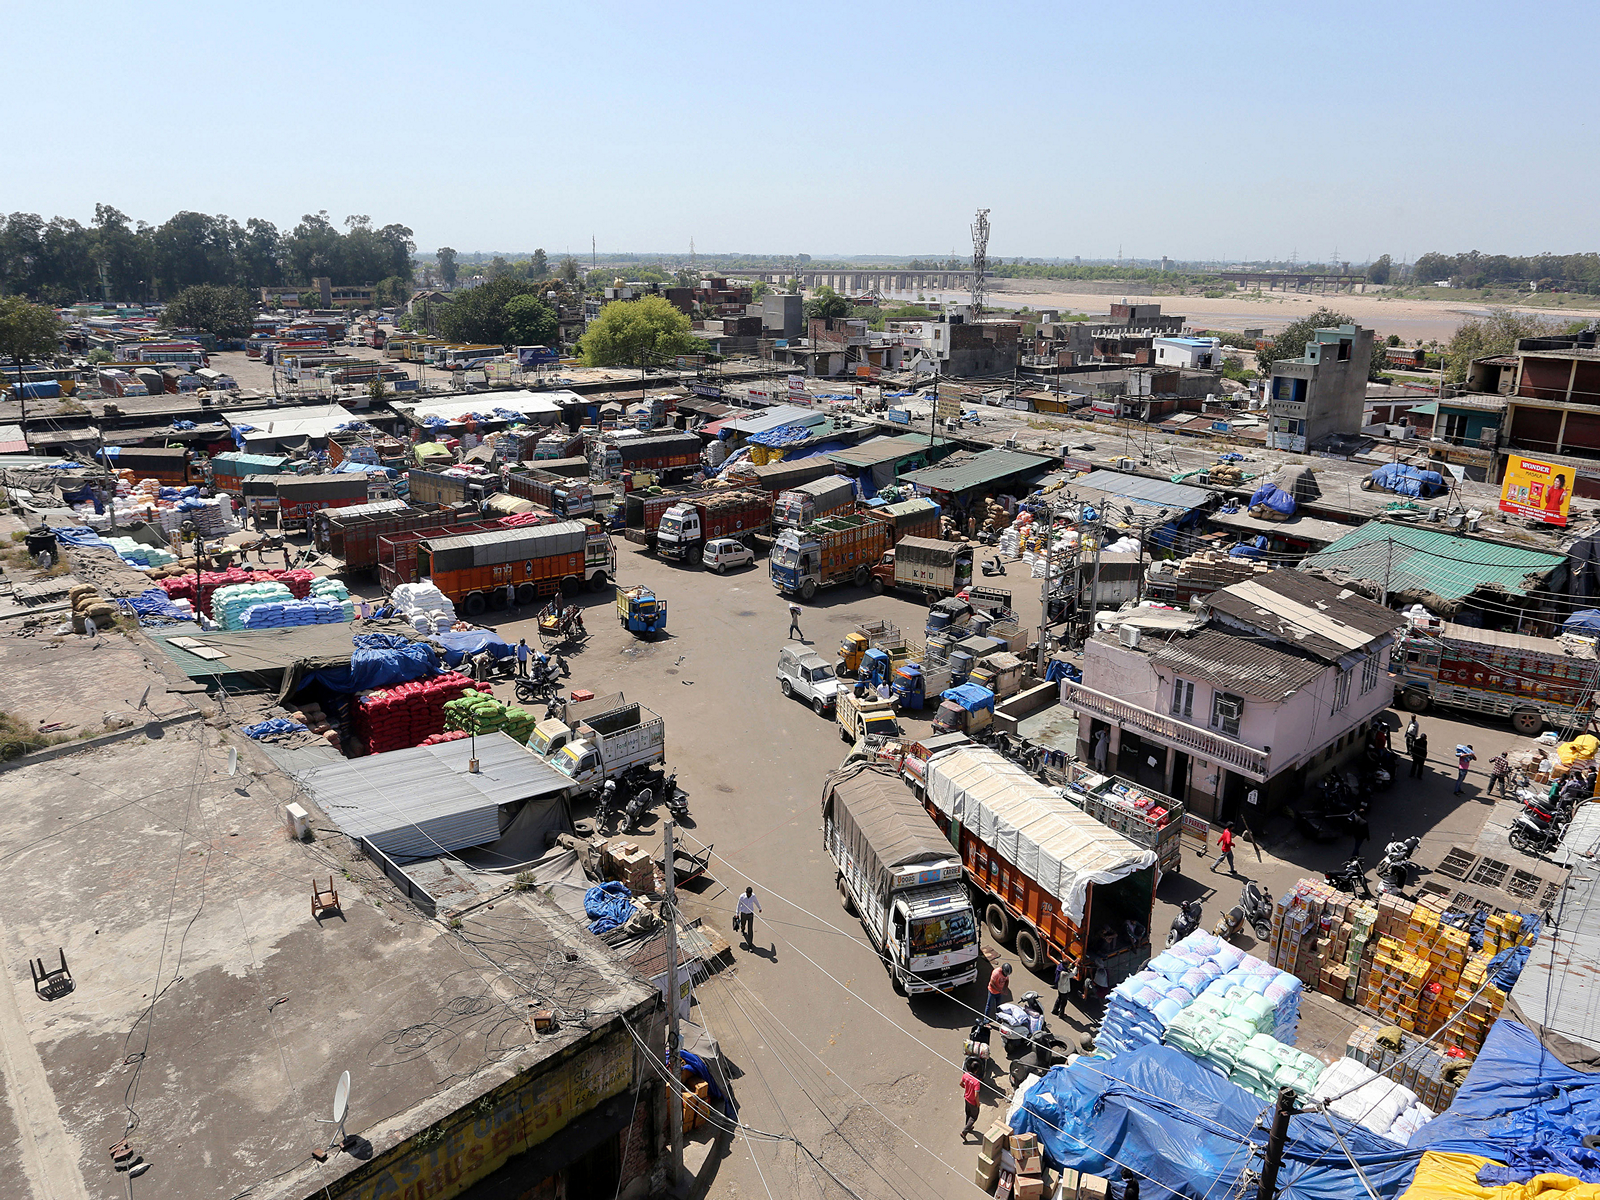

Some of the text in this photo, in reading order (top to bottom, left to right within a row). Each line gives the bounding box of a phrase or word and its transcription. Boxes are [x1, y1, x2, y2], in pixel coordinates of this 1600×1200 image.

[1522, 461, 1550, 474] WONDER
[1525, 471, 1543, 479] MASALA
[296, 502, 320, 516] KTS
[1190, 818, 1207, 831] PARKING
[897, 865, 961, 885] GOODS CARRIER
[491, 1091, 566, 1158] BEST
[350, 1081, 548, 1200] TASTE ONCE
